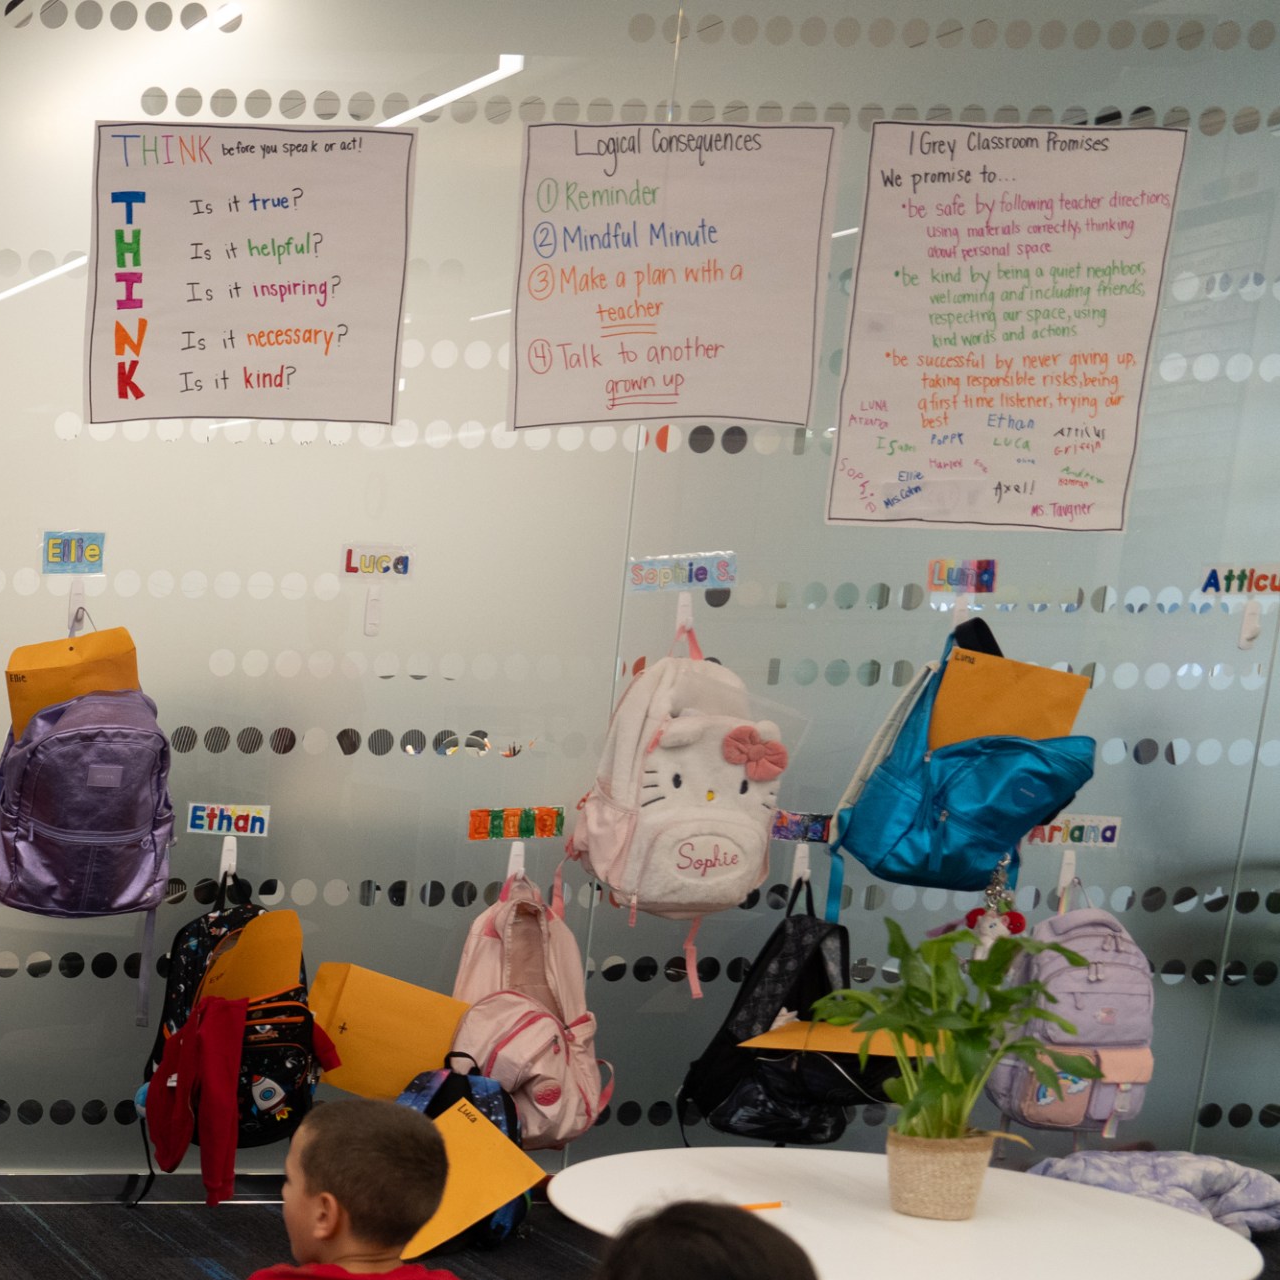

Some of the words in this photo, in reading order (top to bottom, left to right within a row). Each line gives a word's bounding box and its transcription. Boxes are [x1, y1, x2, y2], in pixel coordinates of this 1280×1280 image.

[111, 134, 213, 167] THINK
[222, 140, 256, 157] before
[260, 143, 278, 159] you
[283, 139, 319, 162] speak
[324, 140, 339, 152] or
[339, 136, 363, 153] act!
[575, 129, 643, 177] Logical
[652, 126, 763, 167] Consequences
[920, 130, 957, 161] Grey
[967, 131, 1040, 152] Classroom
[1046, 131, 1111, 153] Promises
[565, 179, 660, 212] Reminder
[880, 168, 903, 189] We
[911, 168, 972, 194] promise
[189, 199, 214, 215] Is
[228, 195, 240, 212] it
[249, 187, 304, 211] true?
[936, 193, 967, 218] safe
[975, 192, 996, 223] by
[999, 190, 1055, 221] following
[1059, 192, 1103, 212] teacher
[563, 221, 640, 253] Mindful
[649, 218, 720, 249] Minute
[1086, 217, 1135, 240] thinking
[190, 243, 212, 261] Is
[225, 241, 238, 258] it
[247, 232, 324, 265] helpful?
[961, 241, 1011, 262] personal
[1017, 241, 1052, 261] space
[186, 281, 214, 302] Is
[228, 281, 242, 299] it
[252, 275, 342, 307] inspiring?
[560, 266, 609, 296] Make
[616, 271, 627, 288] a
[635, 262, 677, 298] plan
[684, 258, 725, 284] with
[730, 263, 745, 283] a
[931, 267, 962, 285] kind
[970, 265, 991, 291] by
[997, 262, 1031, 290] being
[1035, 266, 1045, 278] a
[1049, 262, 1081, 285] quiet
[596, 299, 664, 323] teacher
[929, 288, 996, 308] welcoming
[1001, 285, 1026, 303] and
[929, 308, 997, 332] respecting
[1074, 306, 1108, 328] using
[180, 330, 207, 351] Is
[222, 329, 237, 350] it
[246, 323, 349, 357] necessary?
[961, 329, 997, 346] words
[1002, 325, 1026, 342] and
[1031, 323, 1079, 340] actions
[557, 342, 603, 372] Talk
[618, 342, 639, 365] to
[647, 336, 726, 368] another
[917, 350, 986, 370] successful
[995, 354, 1015, 379] by
[1022, 352, 1062, 371] never
[1069, 351, 1110, 374] giving
[178, 371, 204, 393] Is
[214, 369, 230, 390] it
[242, 364, 298, 391] kind?
[605, 375, 657, 411] grown
[662, 371, 685, 396] up
[921, 372, 962, 396] taking
[966, 371, 1036, 393] responsible
[964, 393, 995, 410] time
[1056, 392, 1099, 420] trying
[921, 412, 950, 430] best
[986, 412, 1036, 431] Ethan
[48, 537, 101, 563] Ellie
[345, 548, 410, 575] Luca
[631, 561, 709, 593] Sophie
[715, 559, 737, 583] S.
[933, 560, 995, 587] Luna
[190, 805, 266, 834] Ethan
[1028, 819, 1117, 845] Ariana
[676, 841, 740, 877] Sophie
[457, 1103, 478, 1123] Luca
